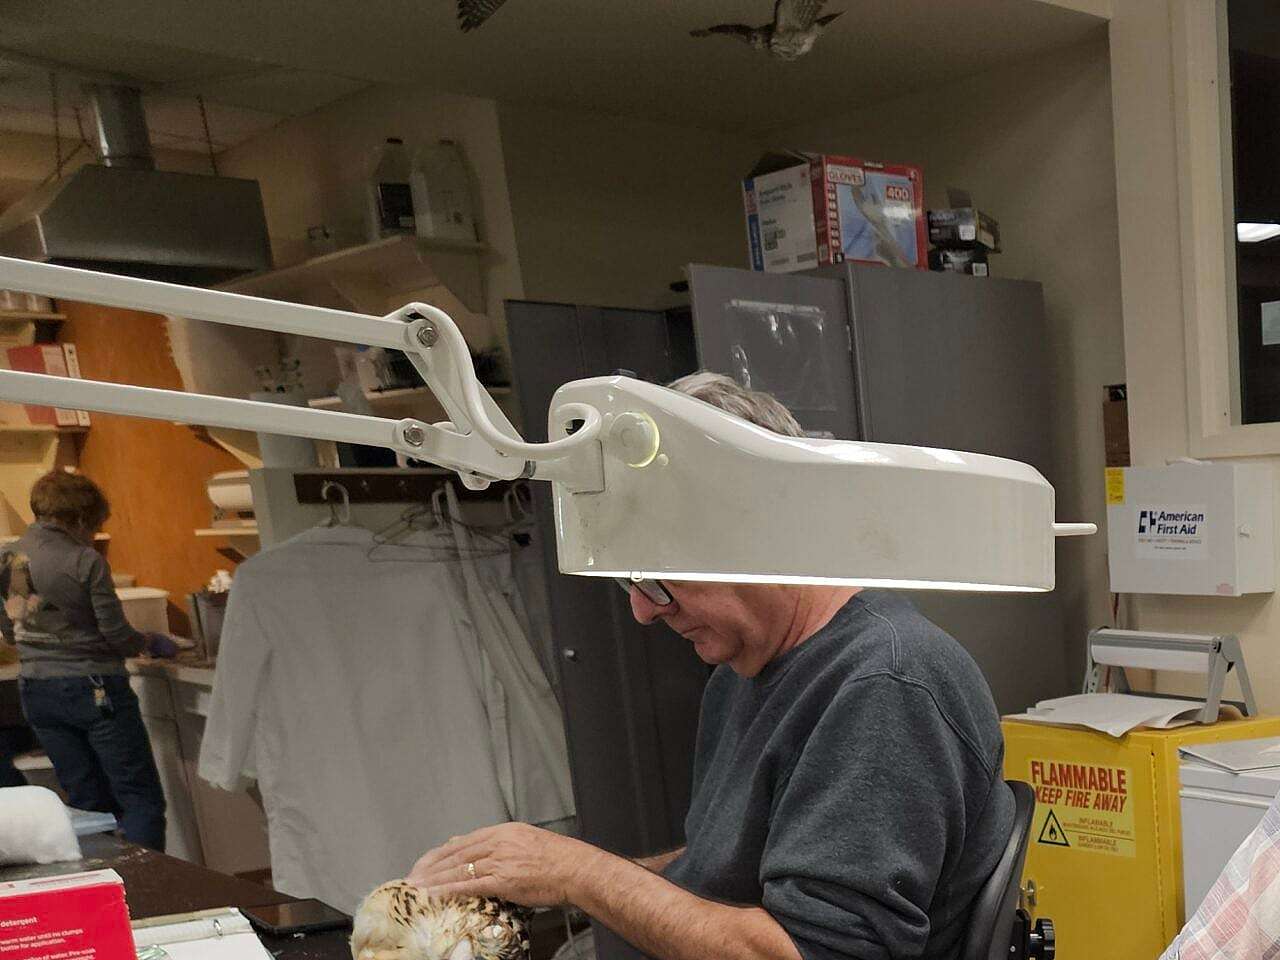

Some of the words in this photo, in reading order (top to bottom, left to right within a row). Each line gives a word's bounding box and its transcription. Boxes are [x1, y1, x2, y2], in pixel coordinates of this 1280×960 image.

[887, 186, 909, 200] 400
[1158, 510, 1204, 522] American
[1157, 524, 1178, 534] First
[1180, 524, 1197, 534] Aid
[1031, 760, 1128, 794] FLAMMABLE
[1036, 786, 1062, 805] KEEP
[1066, 790, 1092, 808] FIRE
[1094, 794, 1128, 814] AWAY
[0, 916, 37, 927] detergent
[30, 938, 65, 947] application.
